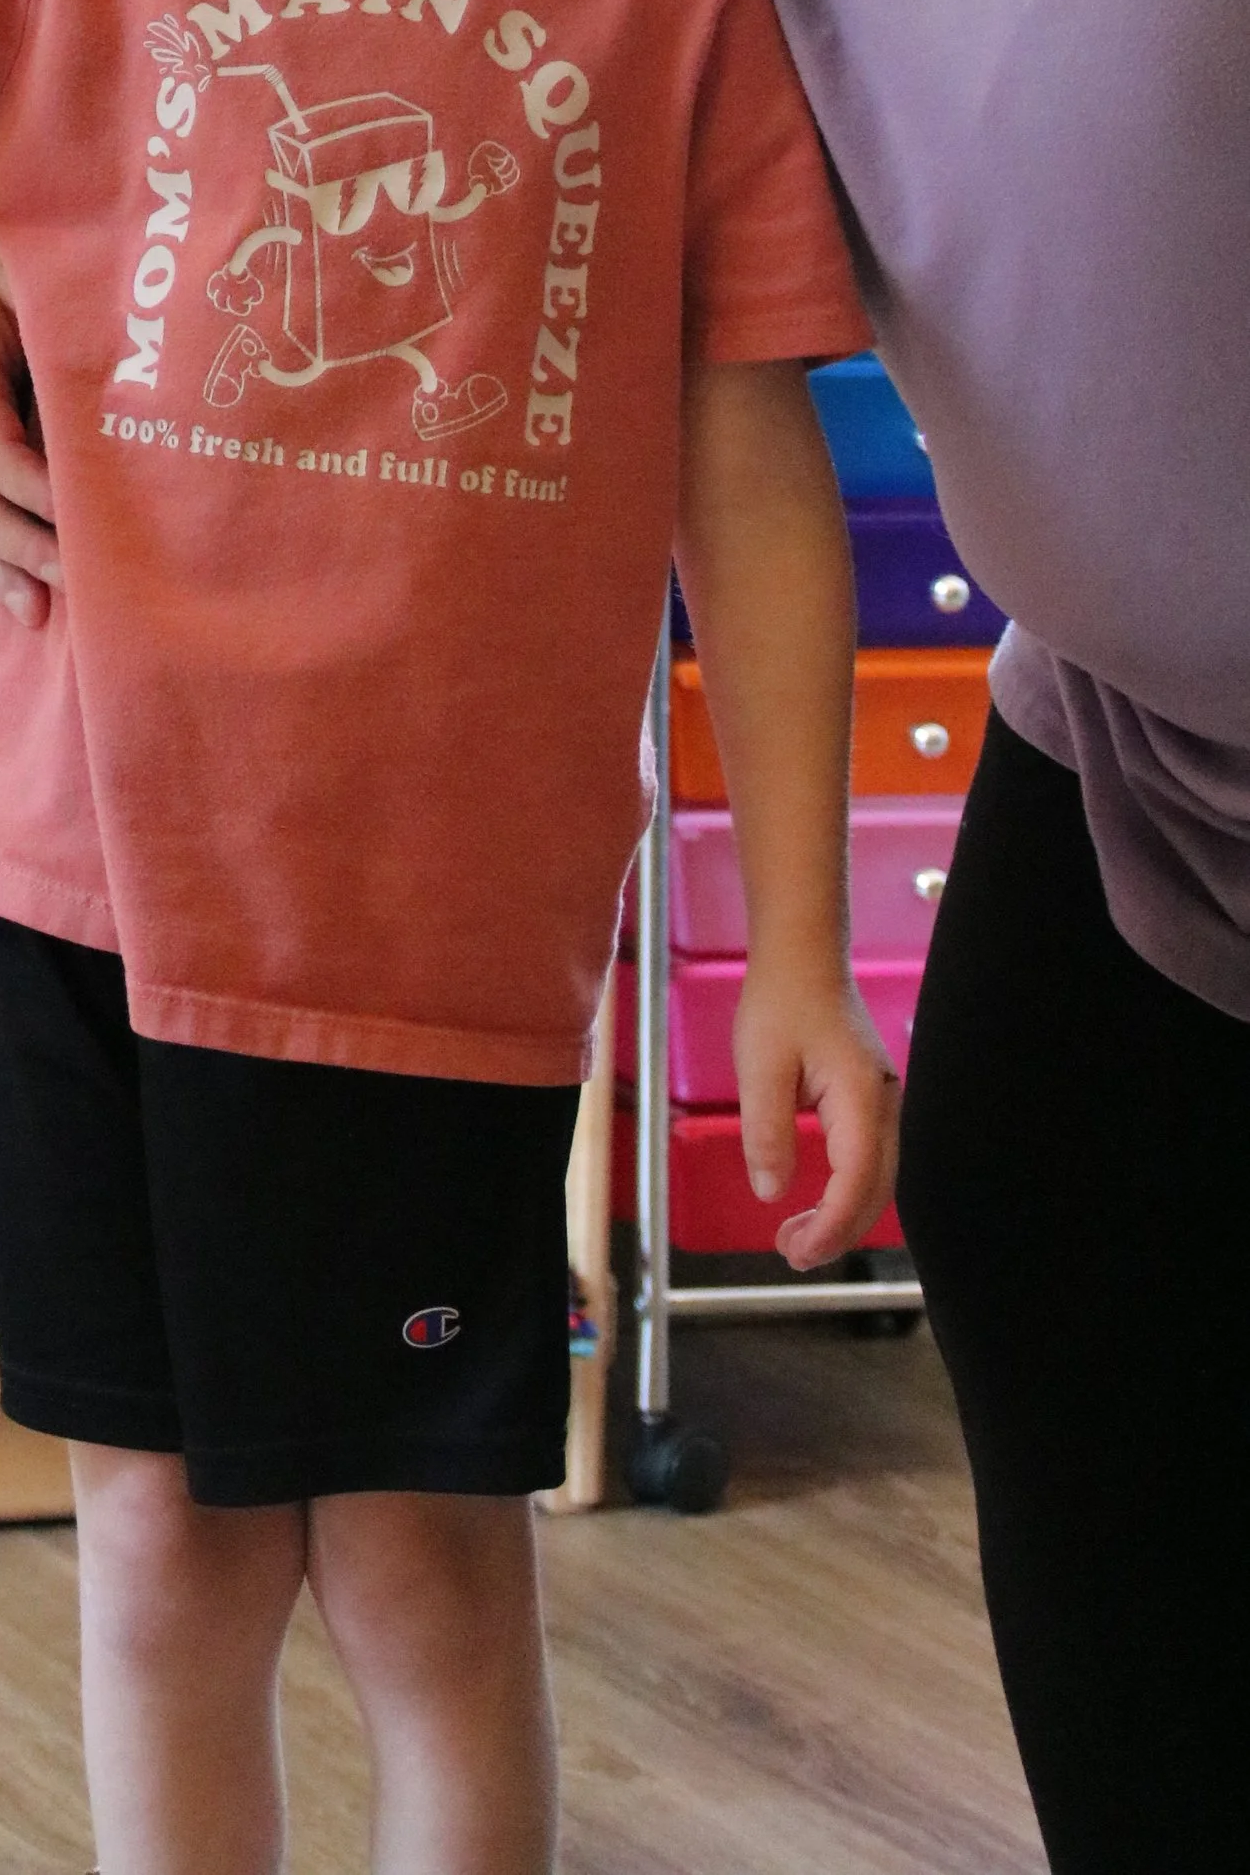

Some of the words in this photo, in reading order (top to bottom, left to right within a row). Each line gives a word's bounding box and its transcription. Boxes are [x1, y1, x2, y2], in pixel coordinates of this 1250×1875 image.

[113, 75, 198, 391] MOM'S
[482, 10, 602, 447] SQUEEZE
[97, 412, 180, 449] 100%
[189, 424, 285, 466] fresh
[296, 448, 368, 477] and
[378, 451, 449, 488] full
[459, 464, 497, 494] of
[504, 468, 568, 502] fun!
